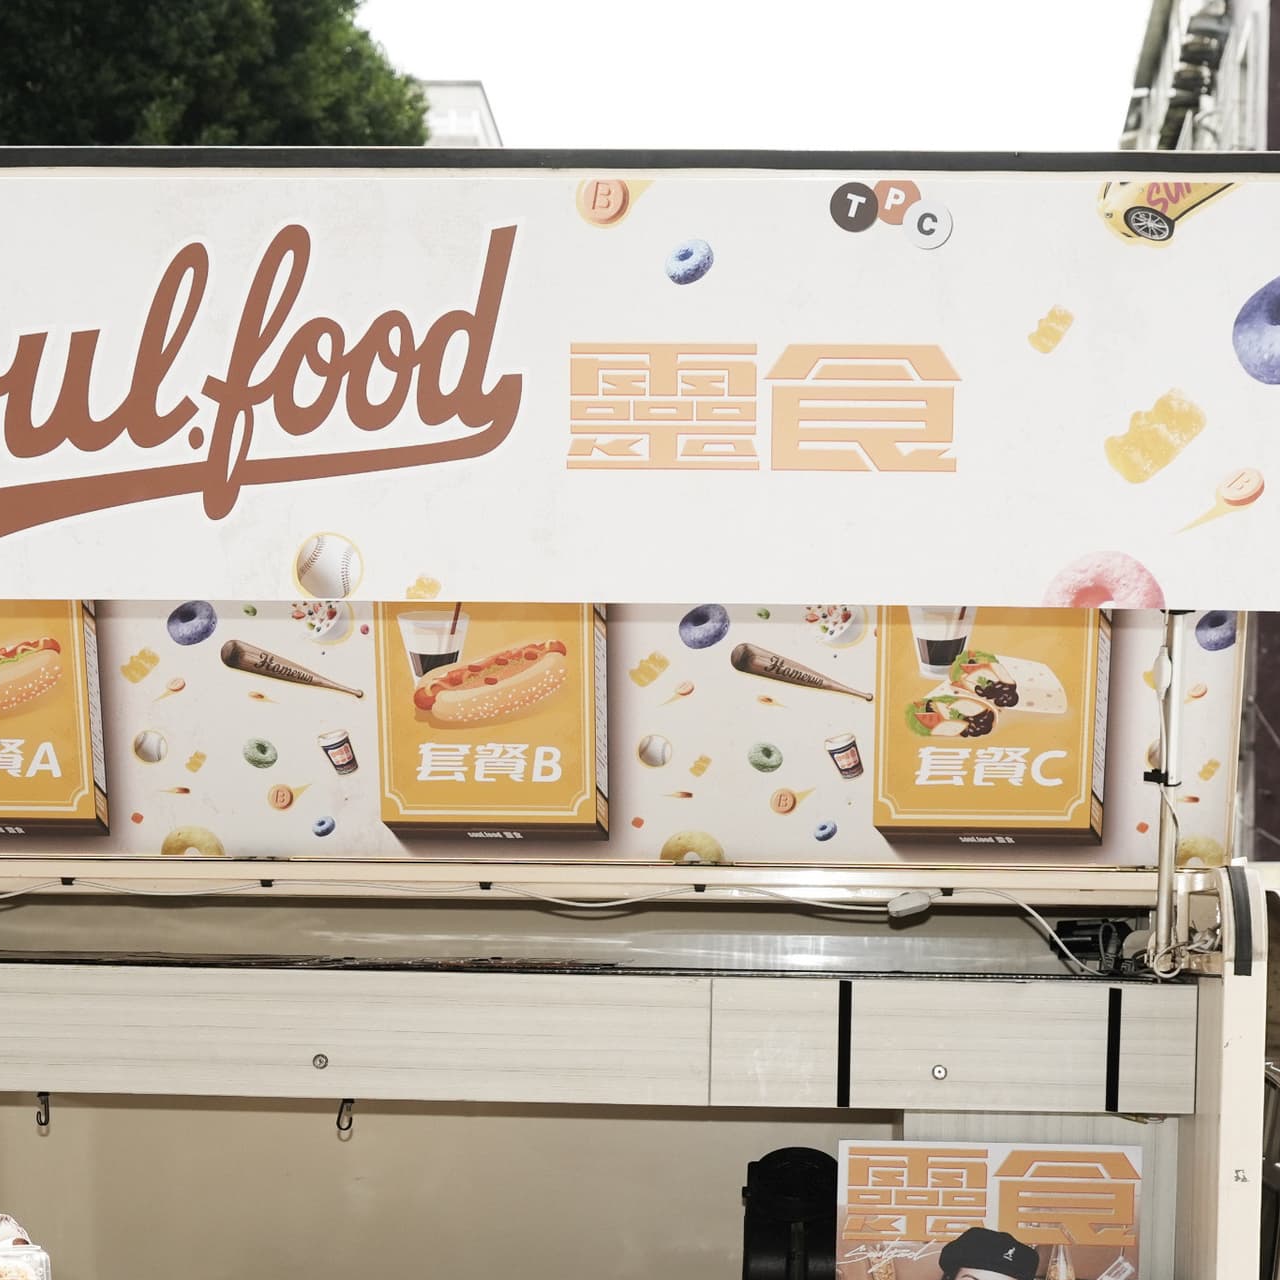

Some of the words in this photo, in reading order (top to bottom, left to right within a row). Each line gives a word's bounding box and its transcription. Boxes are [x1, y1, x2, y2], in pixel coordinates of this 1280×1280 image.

[847, 187, 938, 236] TPC
[566, 341, 963, 473] 靈食
[252, 650, 313, 683] Homerun
[761, 655, 823, 686] Homerun
[415, 741, 565, 786] 套餐B
[914, 745, 1068, 788] 套餐C
[842, 1146, 1142, 1246] 靈食
